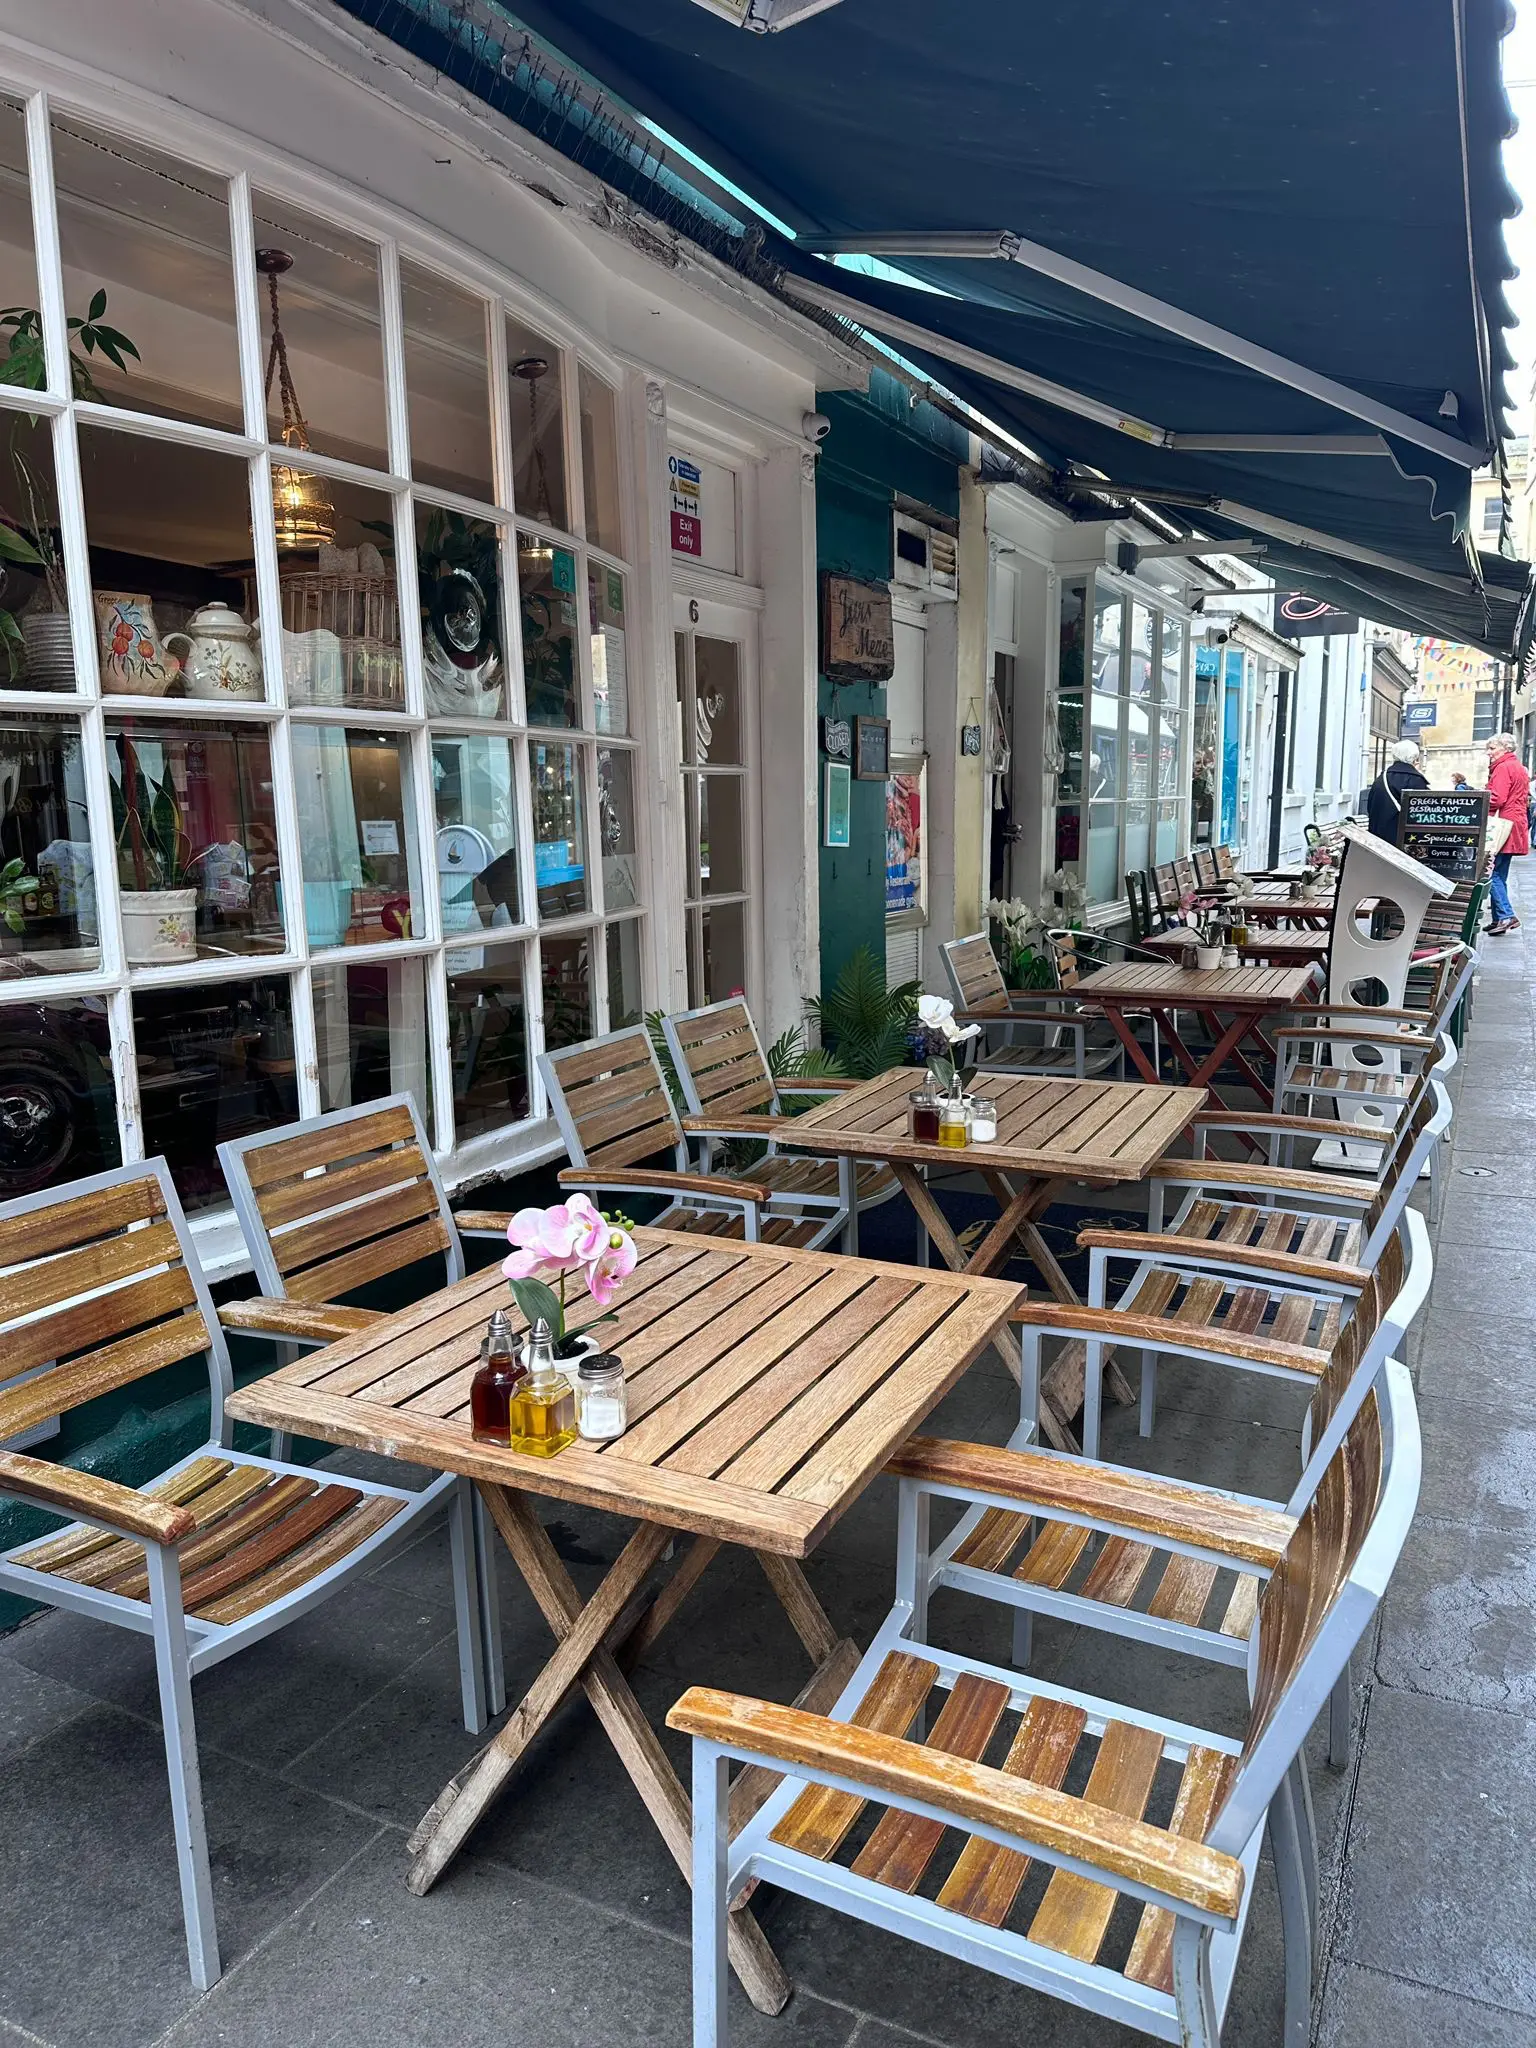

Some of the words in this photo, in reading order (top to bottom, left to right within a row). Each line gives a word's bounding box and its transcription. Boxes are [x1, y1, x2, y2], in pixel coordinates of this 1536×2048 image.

[679, 518, 693, 533] Exit
[679, 534, 694, 550] only
[688, 599, 700, 624] 6
[827, 732, 850, 750] CLOSED
[1409, 797, 1439, 806] GREEK
[1440, 797, 1477, 806] FAMILY
[1409, 805, 1461, 814] RESTAURANT
[1418, 833, 1466, 844] Specials:
[1431, 849, 1450, 857] Gyros
